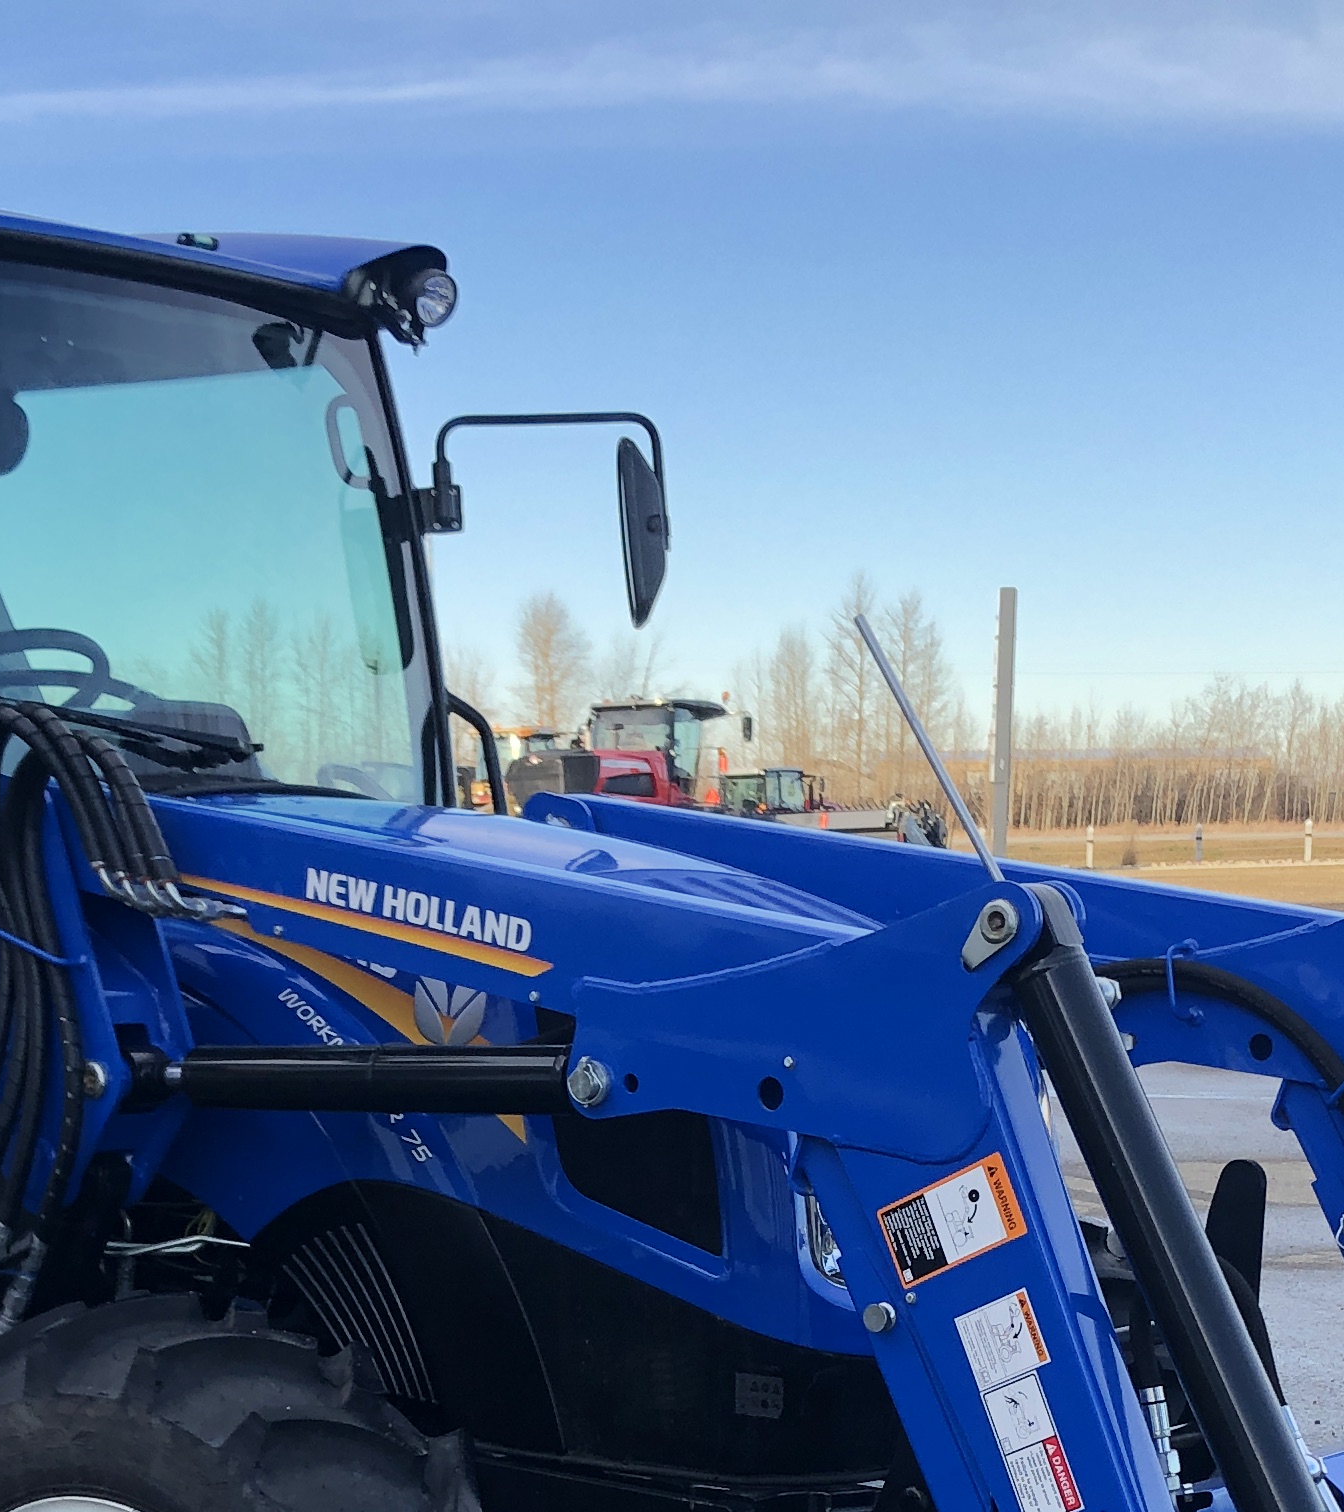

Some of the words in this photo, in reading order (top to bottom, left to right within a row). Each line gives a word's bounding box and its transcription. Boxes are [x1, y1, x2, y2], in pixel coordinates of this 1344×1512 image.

[306, 867, 377, 913] NEW
[382, 885, 532, 951] HOLLAND
[401, 1129, 433, 1162] 75
[993, 1178, 1017, 1231] WARNING
[1024, 1311, 1044, 1356] WARNING
[1052, 1456, 1076, 1506] DANGER
